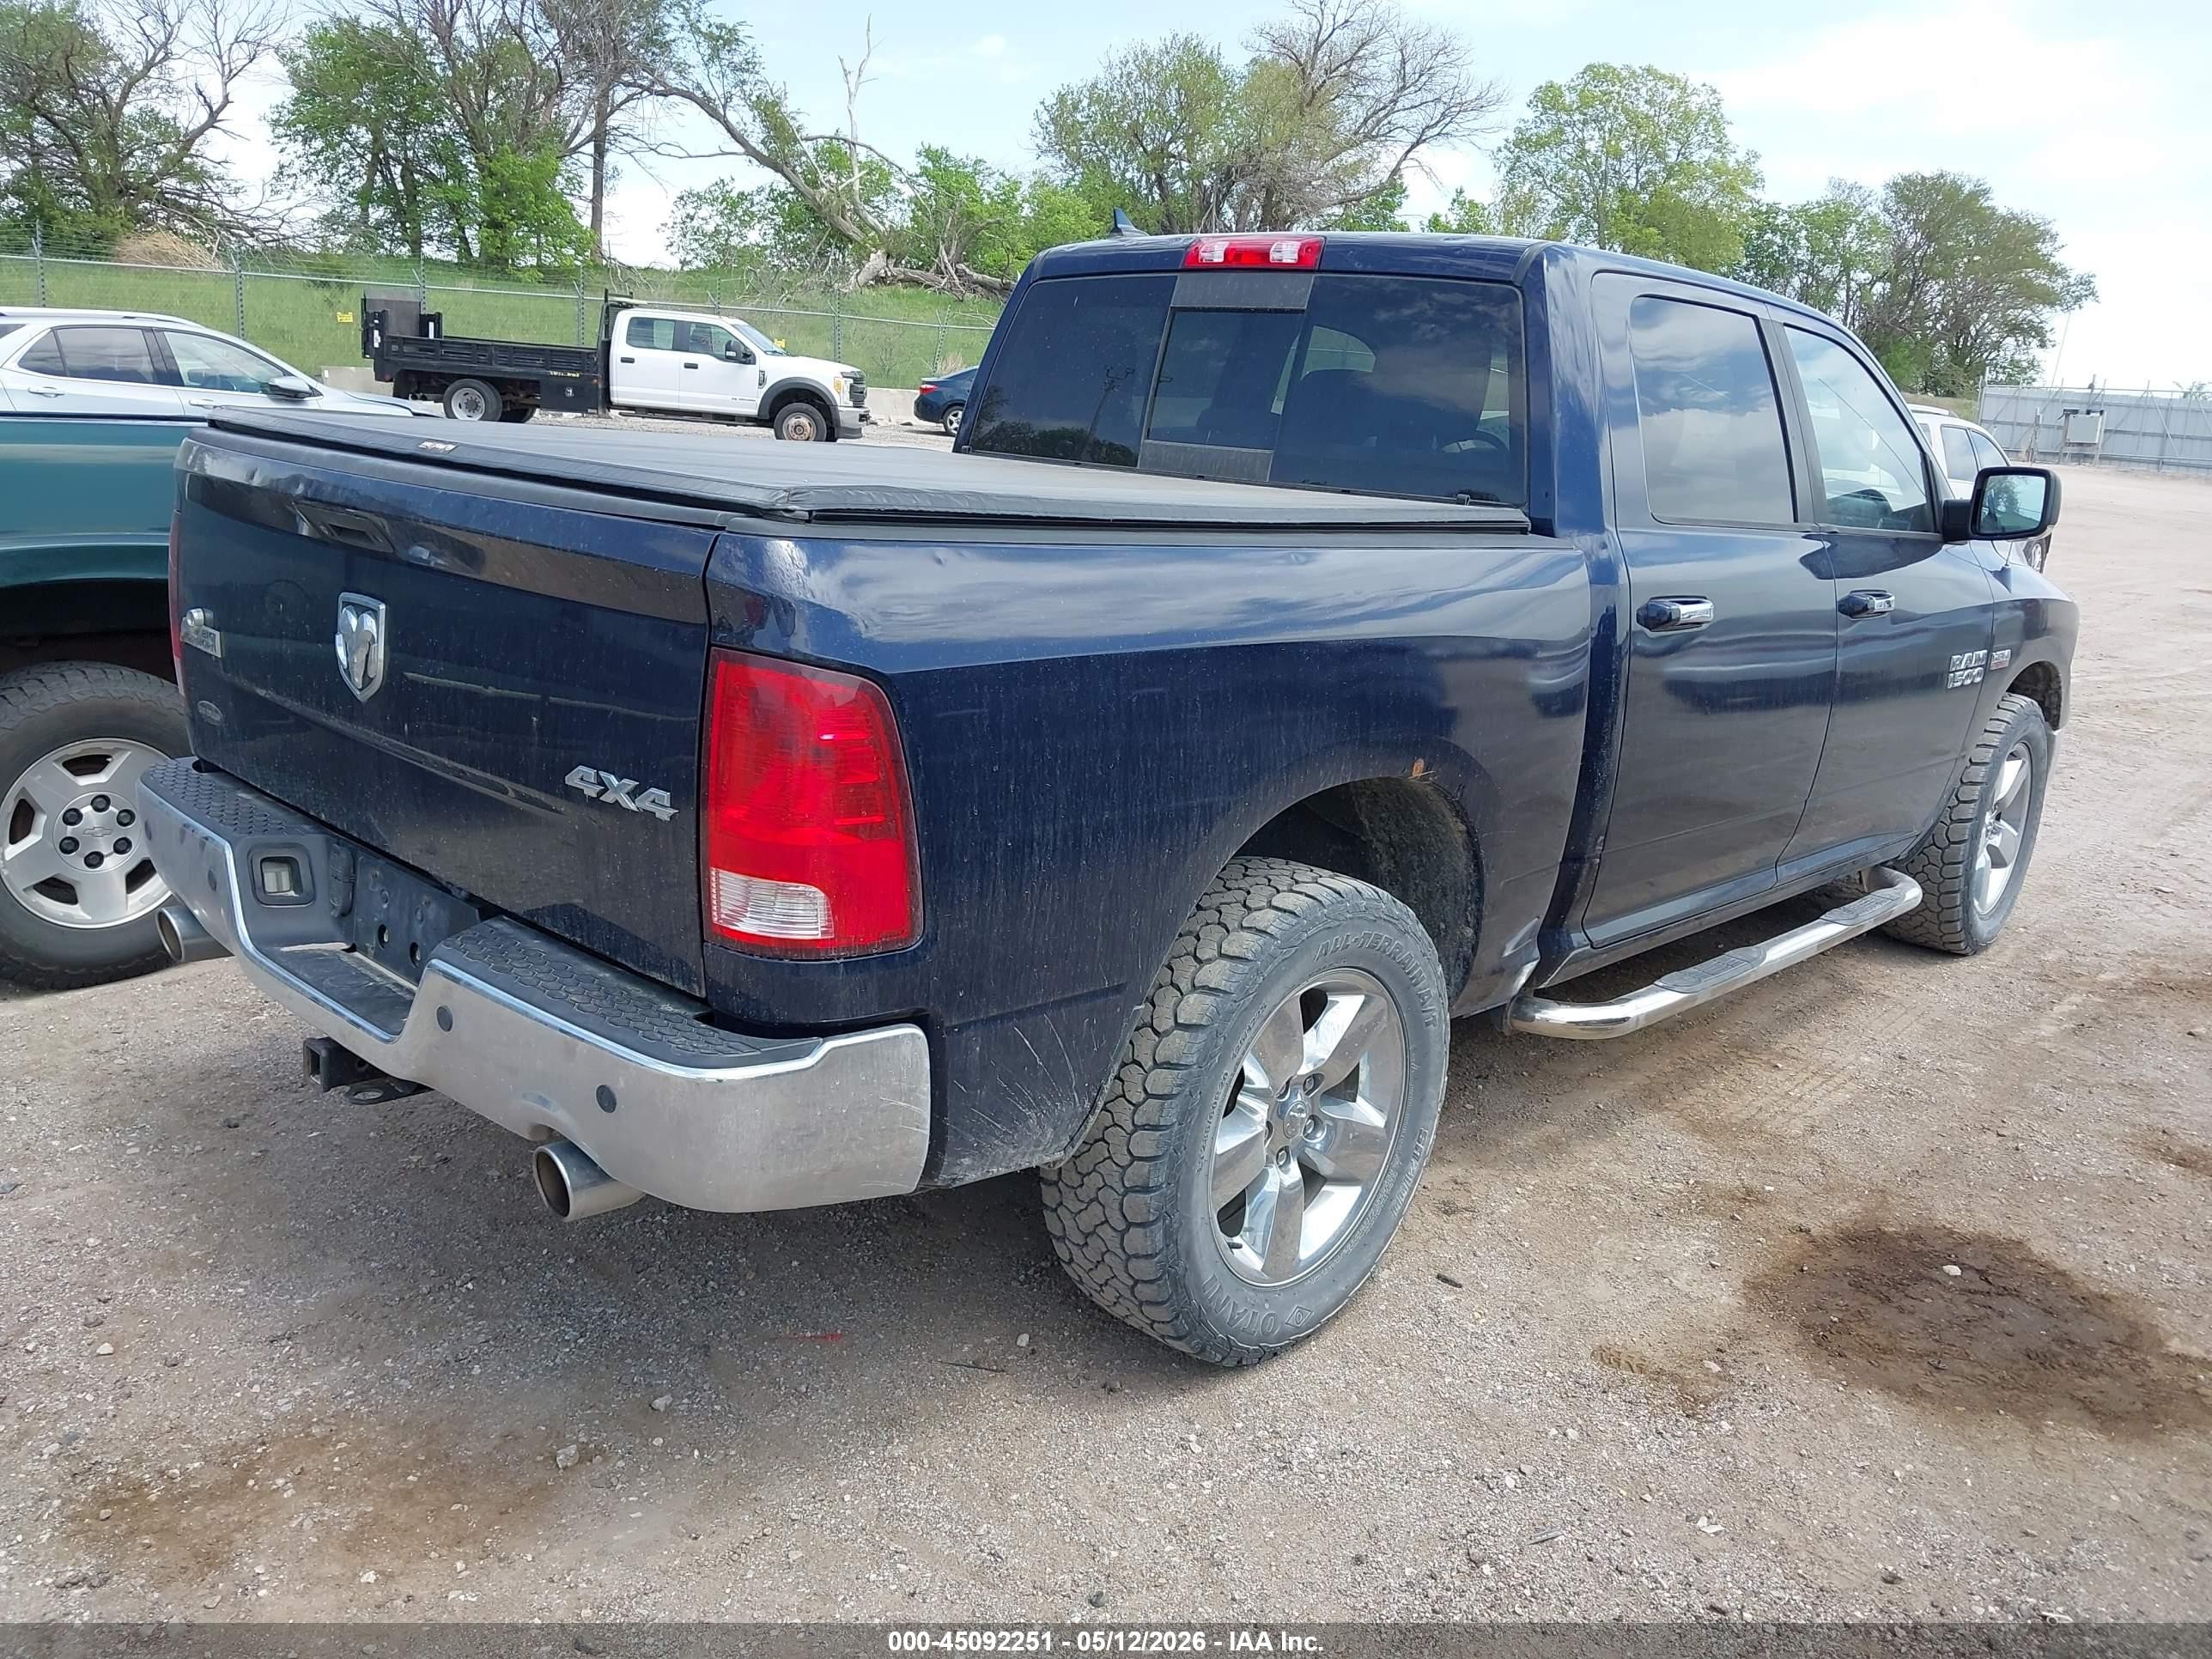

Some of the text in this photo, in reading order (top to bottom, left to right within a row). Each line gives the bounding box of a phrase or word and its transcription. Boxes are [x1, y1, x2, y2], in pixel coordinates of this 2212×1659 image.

[1948, 667, 1984, 689] 1500
[1949, 649, 1988, 672] RAM
[564, 765, 680, 822] 4X4
[1313, 930, 1426, 987] ALL-TERRAIN
[1202, 1274, 1279, 1337] OTANI
